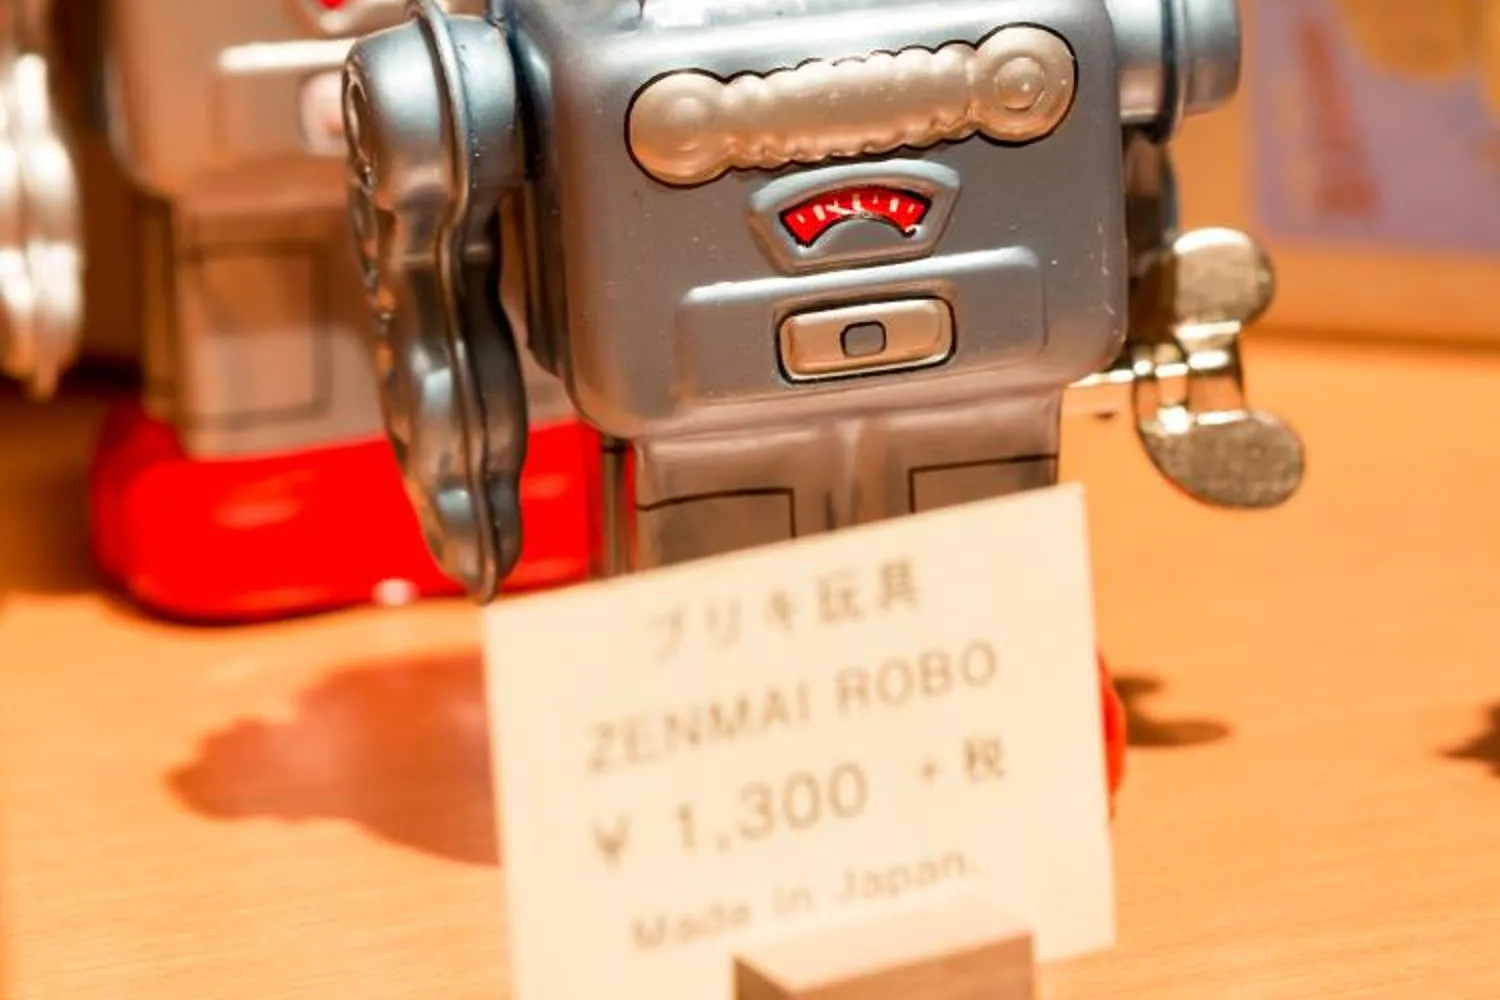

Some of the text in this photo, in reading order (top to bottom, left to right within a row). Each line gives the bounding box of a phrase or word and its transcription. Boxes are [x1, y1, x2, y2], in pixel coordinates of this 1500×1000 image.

[585, 638, 999, 777] ZENMAI ROBO
[630, 899, 752, 951] Made
[775, 879, 812, 919] in
